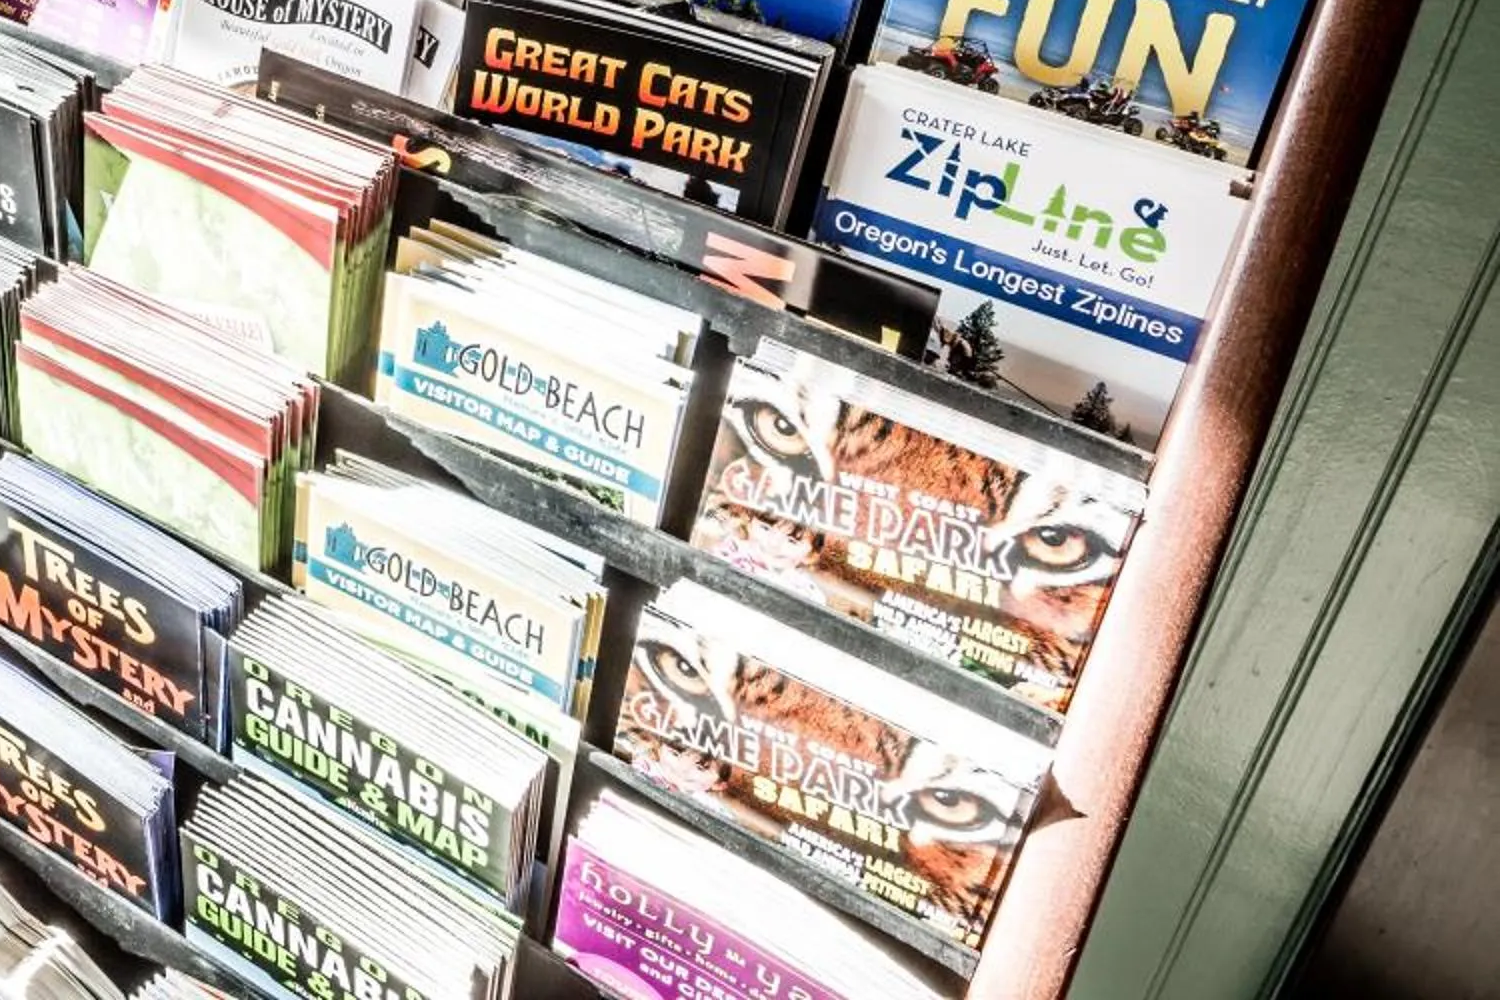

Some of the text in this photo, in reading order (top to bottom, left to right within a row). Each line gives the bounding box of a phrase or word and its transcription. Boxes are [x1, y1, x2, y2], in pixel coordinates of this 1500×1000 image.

[902, 107, 1032, 157] CRATER LAKE
[835, 210, 1183, 346] Oregon's Longest Ziplines
[1031, 238, 1074, 264] Just.
[1119, 266, 1154, 289] Go!
[413, 377, 631, 486] VISITOR MAP & GUIDE
[459, 343, 646, 449] GOLD BEACH
[720, 457, 1020, 582] GAME PARK
[838, 471, 983, 525] WEST COAST
[7, 516, 156, 646] TREES
[67, 598, 105, 629] OF
[366, 545, 545, 656] GOLD BEACH
[846, 539, 1005, 611] SAFARI
[243, 655, 493, 814] OREGON
[245, 680, 491, 850] CANNABIS
[628, 691, 915, 831] GAME PARK
[20, 779, 58, 811] OF
[245, 715, 490, 869] GUIDE & MAP
[750, 774, 904, 854] SAFARI
[196, 895, 334, 996] GUIDE &
[582, 913, 636, 950] VISIT
[640, 948, 690, 982] OUR
